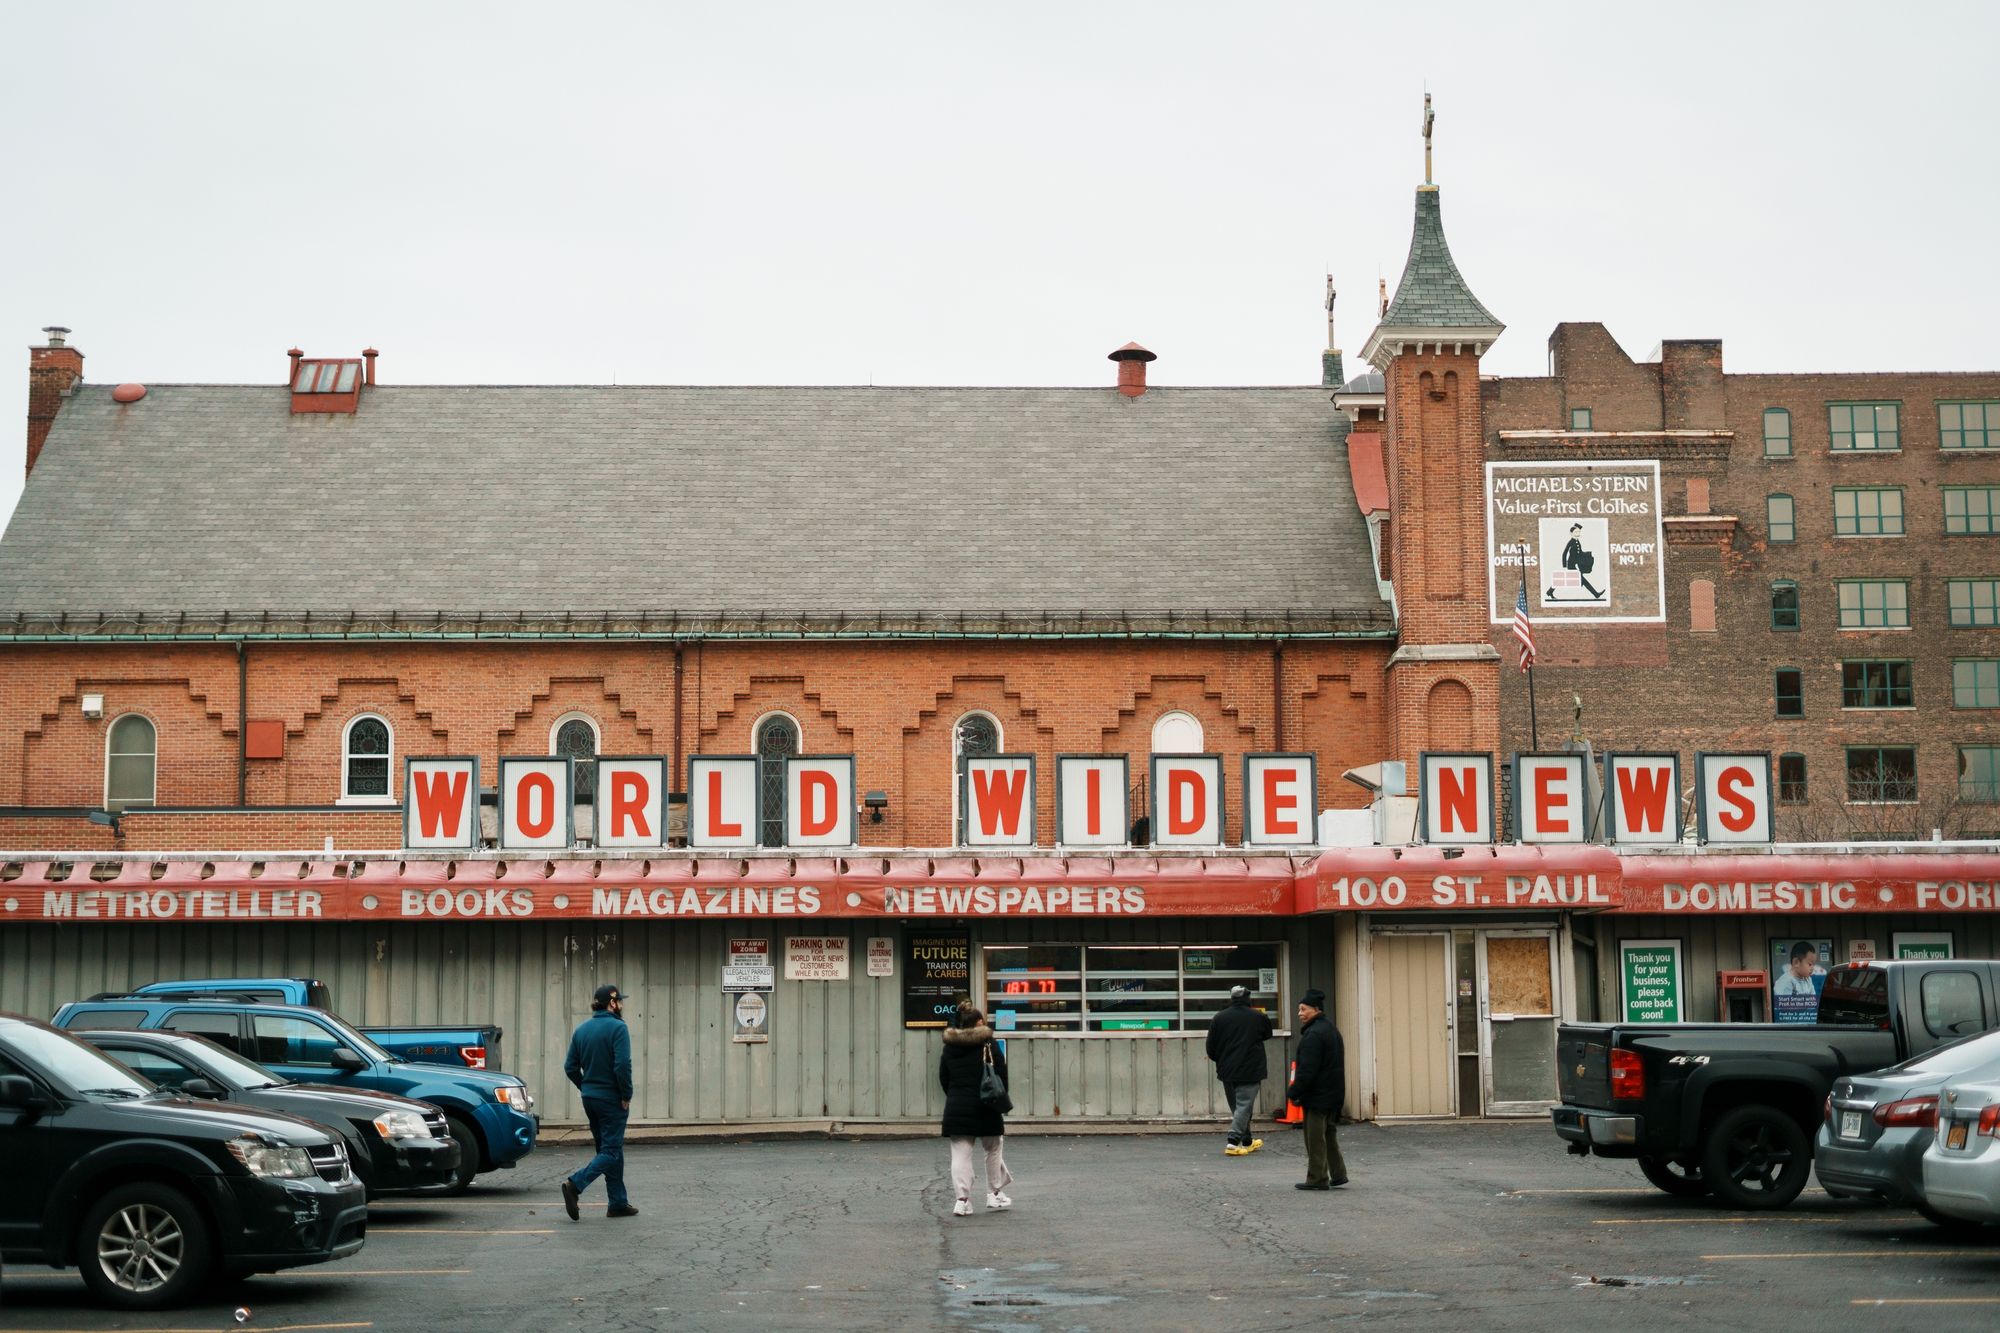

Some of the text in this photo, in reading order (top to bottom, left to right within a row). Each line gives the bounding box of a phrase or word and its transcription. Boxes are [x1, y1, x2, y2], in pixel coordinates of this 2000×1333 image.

[1587, 497, 1649, 514] Clothes
[1500, 543, 1531, 554] MAIN
[1610, 543, 1655, 553] FACTORY
[1494, 556, 1538, 567] OFFICES
[413, 766, 1756, 839] WORLD WIDE NEWS
[1332, 874, 1609, 906] 100 ST. PAUL
[42, 884, 1146, 918] METROTELLER BOOKS MAGAZINES NEWSPAPERS
[1663, 881, 2000, 911] DOMESTIC FOR
[790, 939, 845, 949] PARKING ONLY
[869, 949, 892, 957] LOITERING
[913, 947, 967, 959] FUTURE
[1851, 951, 1874, 959] LOITERING
[1903, 949, 1945, 960] Thank you
[1628, 953, 1671, 965] Thank you
[799, 962, 834, 970] CUSTOMERS
[926, 961, 967, 970] TRAIN FOR
[1634, 964, 1668, 976] for your
[725, 968, 771, 976] ILLEGALLY PARKED
[926, 970, 967, 978] A CAREER
[1633, 976, 1671, 986] business,
[1732, 976, 1758, 985] frontier
[1637, 987, 1665, 998] please
[1630, 998, 1674, 1009] come back
[1641, 1009, 1664, 1020] soon!
[1119, 1022, 1146, 1030] Newport
